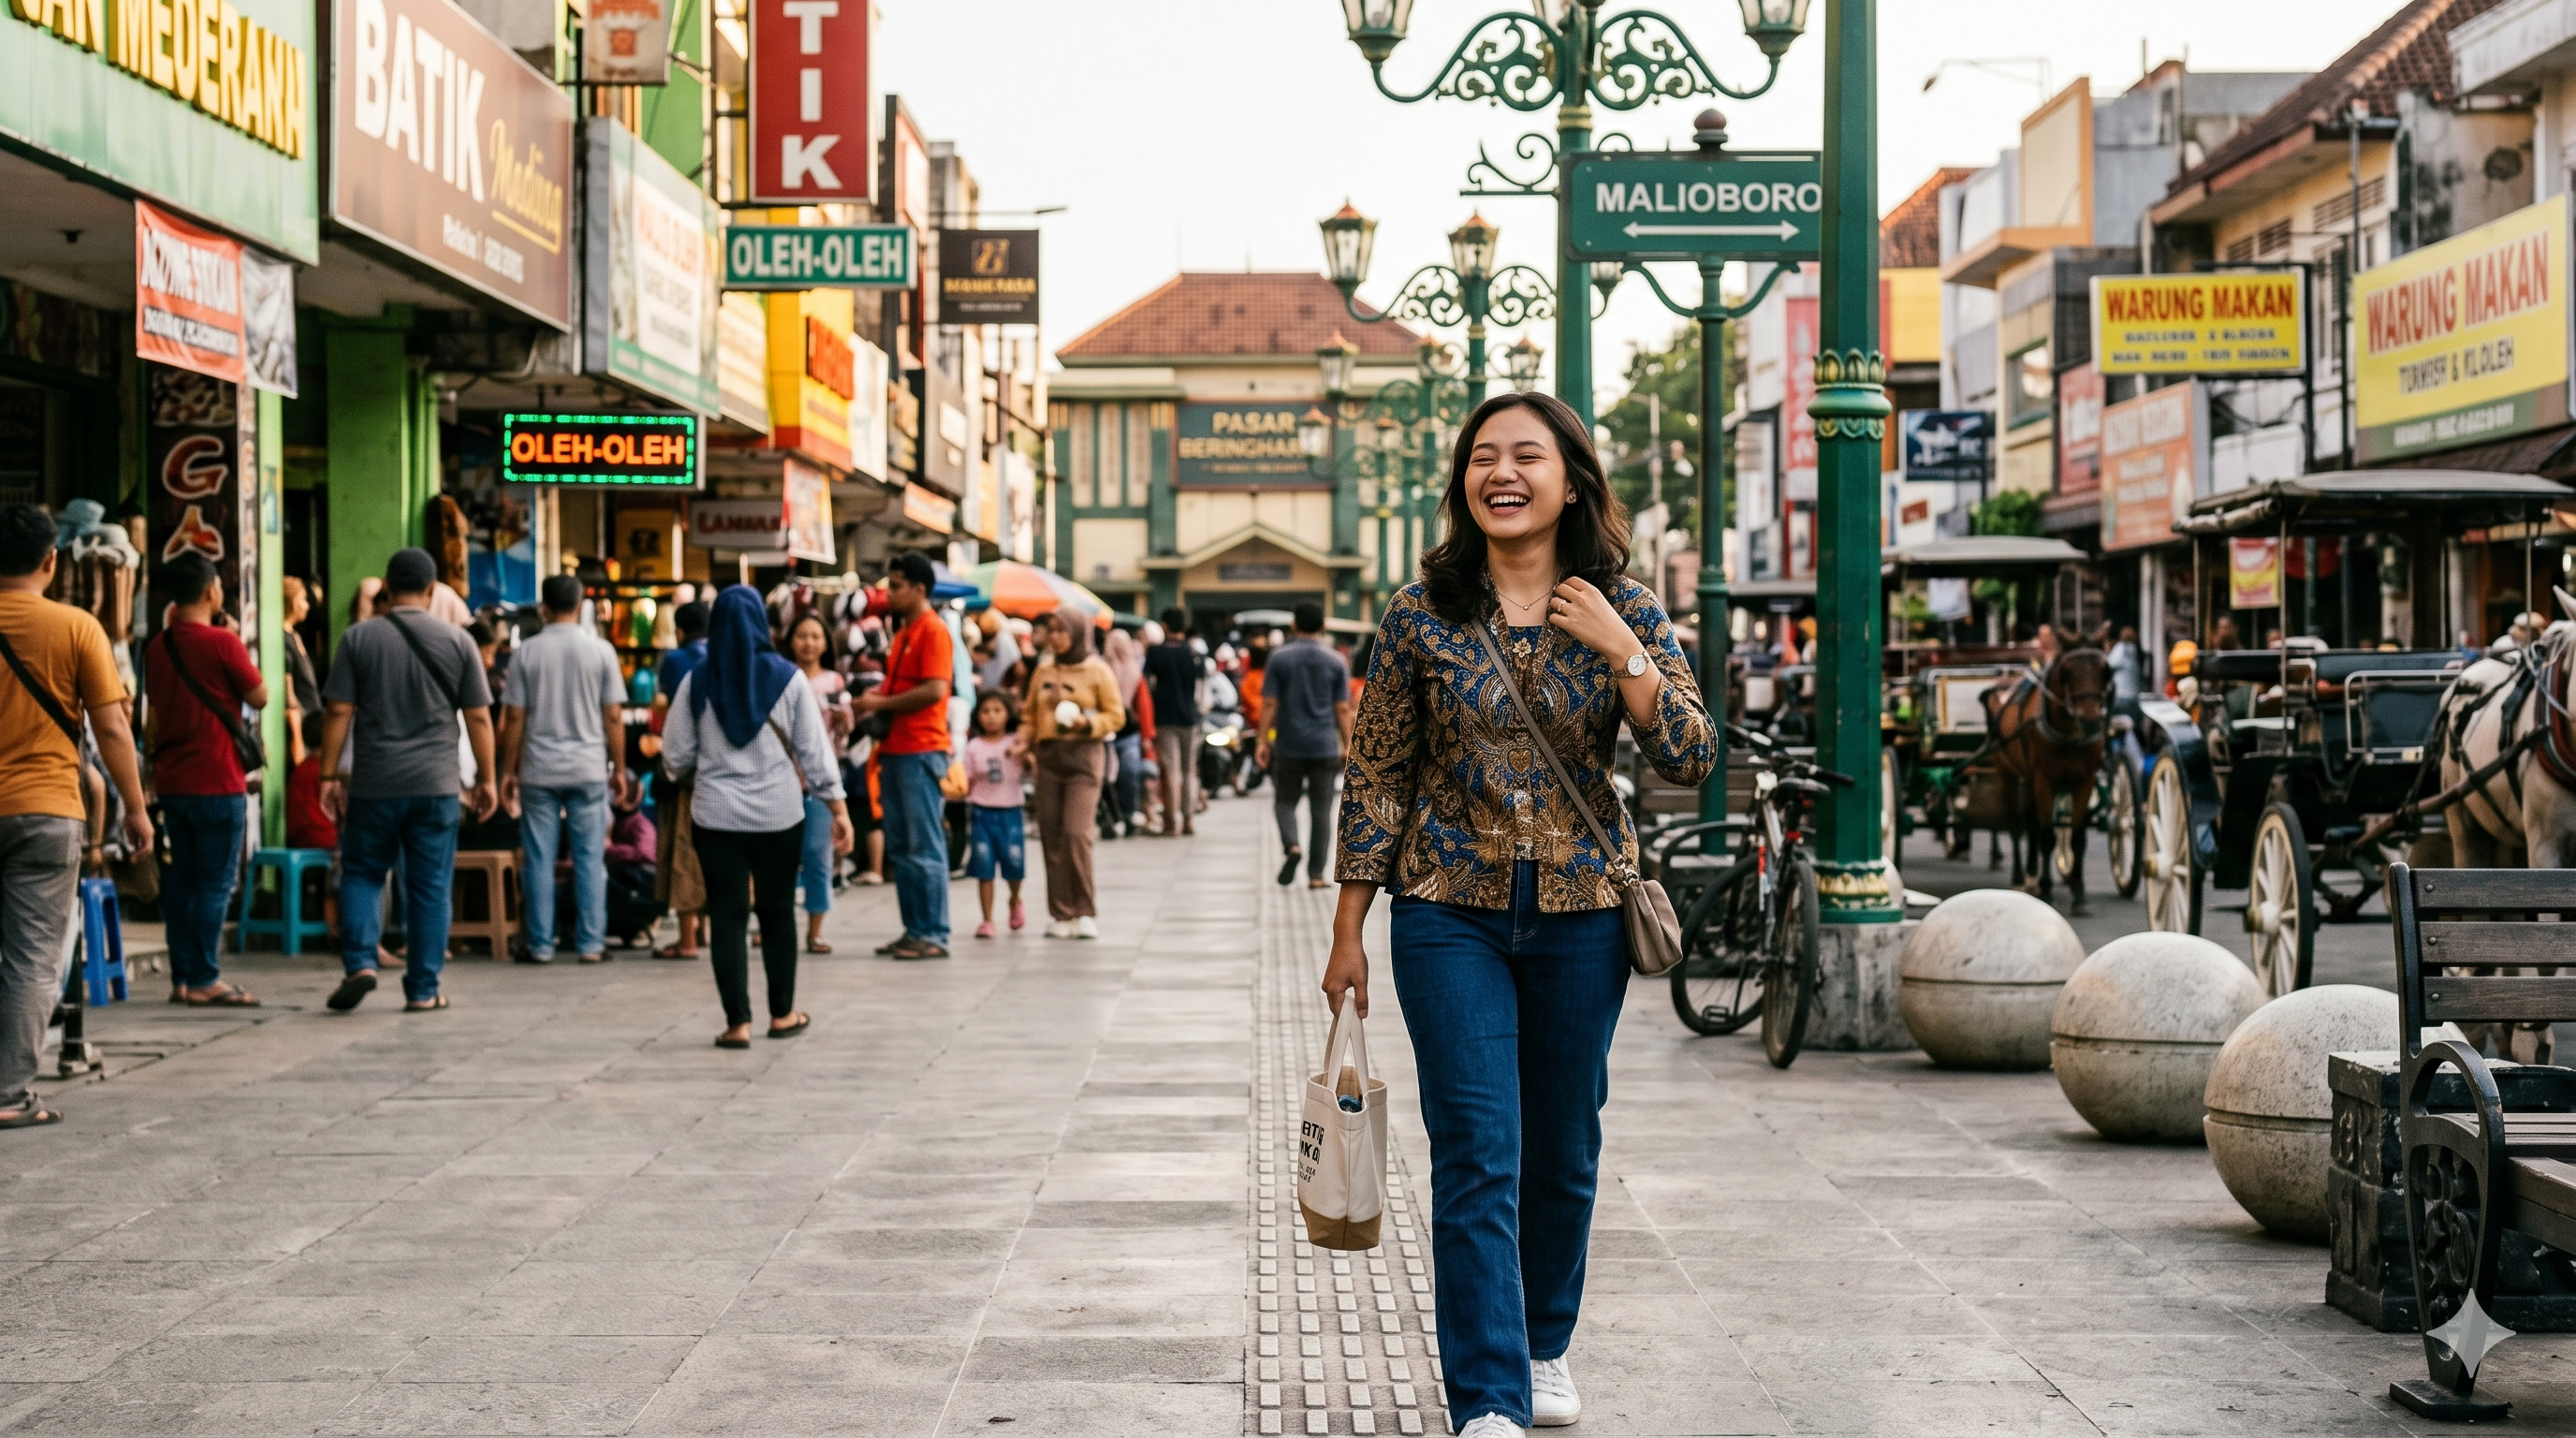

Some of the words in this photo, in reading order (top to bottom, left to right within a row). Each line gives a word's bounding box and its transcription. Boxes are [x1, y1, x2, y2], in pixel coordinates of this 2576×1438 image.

[355, 0, 484, 203] BATIK
[1596, 182, 1823, 213] MALIOBORO
[731, 235, 904, 278] OLEH-OLEH
[2106, 287, 2204, 322] WARUNG
[2211, 283, 2292, 320] MAKAN
[2365, 265, 2457, 355] WARUNG
[2464, 228, 2550, 328] MAKAN
[1212, 412, 1296, 434] PASAR
[511, 433, 685, 464] OLEH-OLEH
